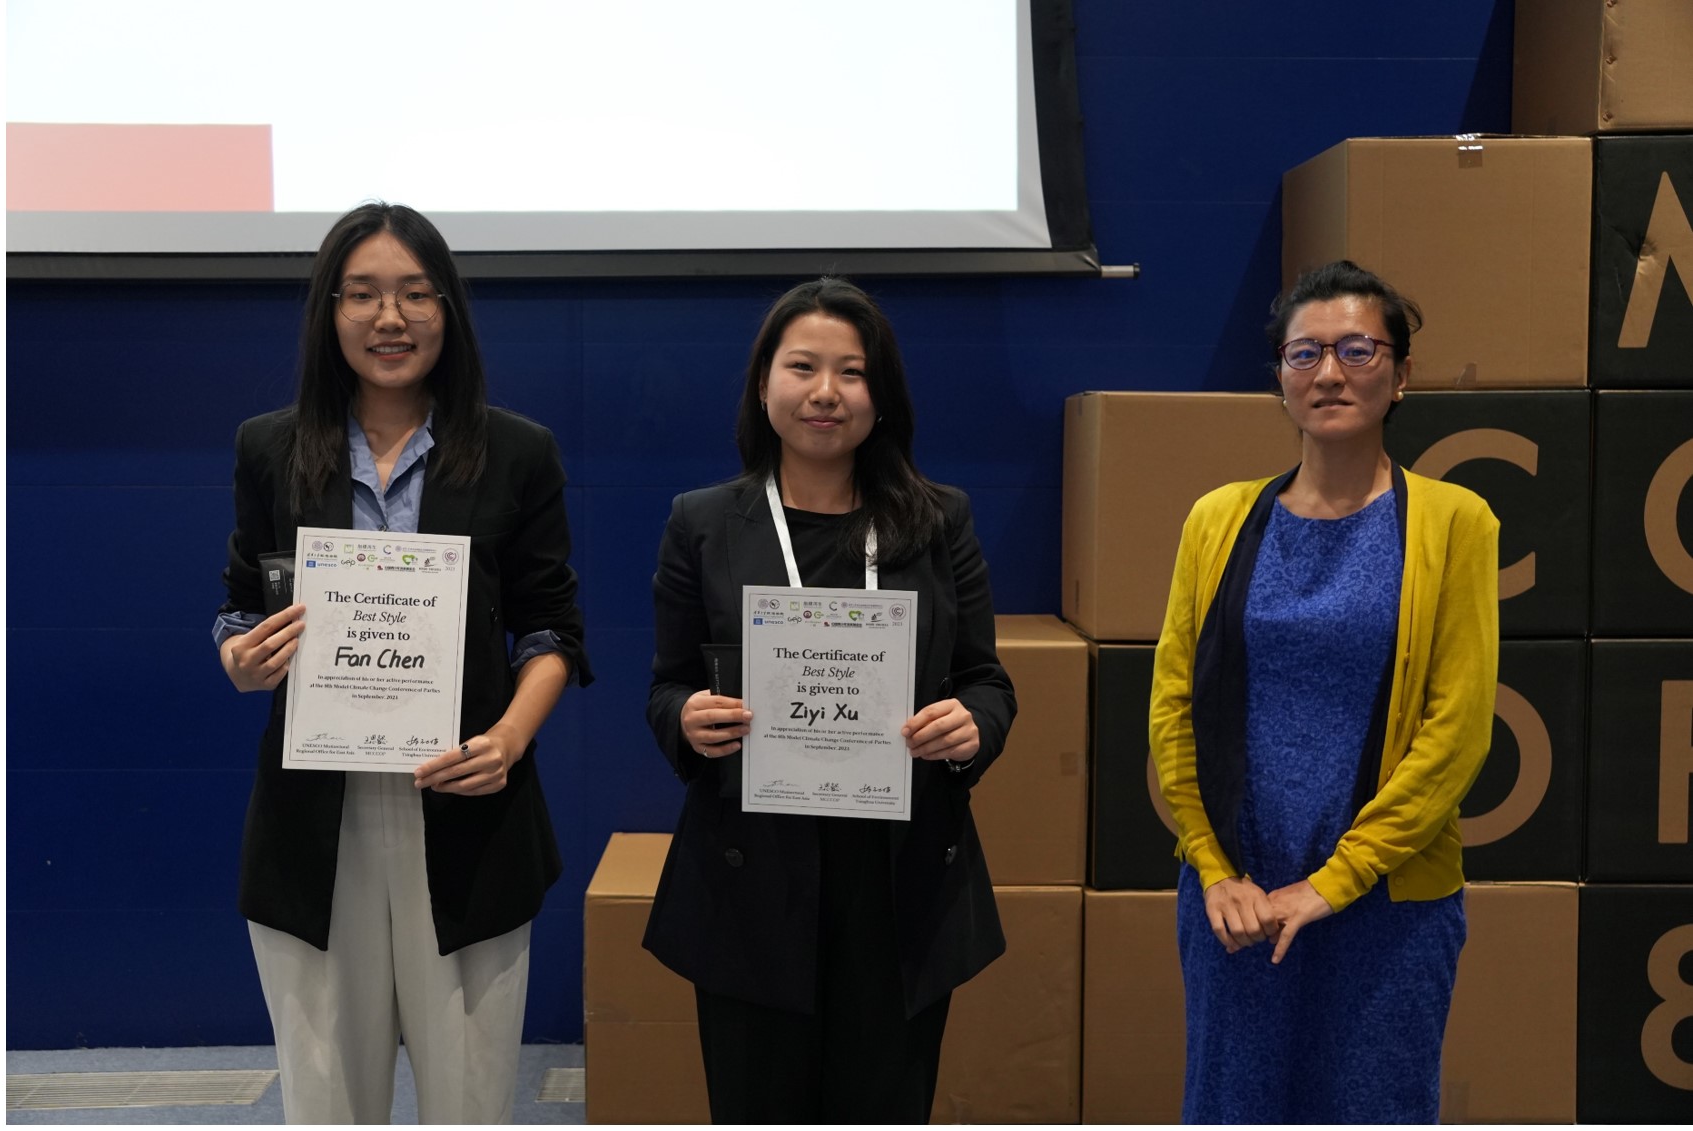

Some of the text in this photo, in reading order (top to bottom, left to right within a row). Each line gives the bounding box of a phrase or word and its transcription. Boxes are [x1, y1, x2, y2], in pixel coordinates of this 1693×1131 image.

[325, 591, 438, 607] The Certificate of
[353, 610, 406, 625] Best Style
[347, 628, 410, 641] is given to
[335, 646, 425, 669] Fan Chen
[773, 648, 886, 662] The Certificate of
[802, 666, 855, 680] Best Style
[797, 682, 859, 696] is given to
[790, 702, 858, 726] Ziyi Xu
